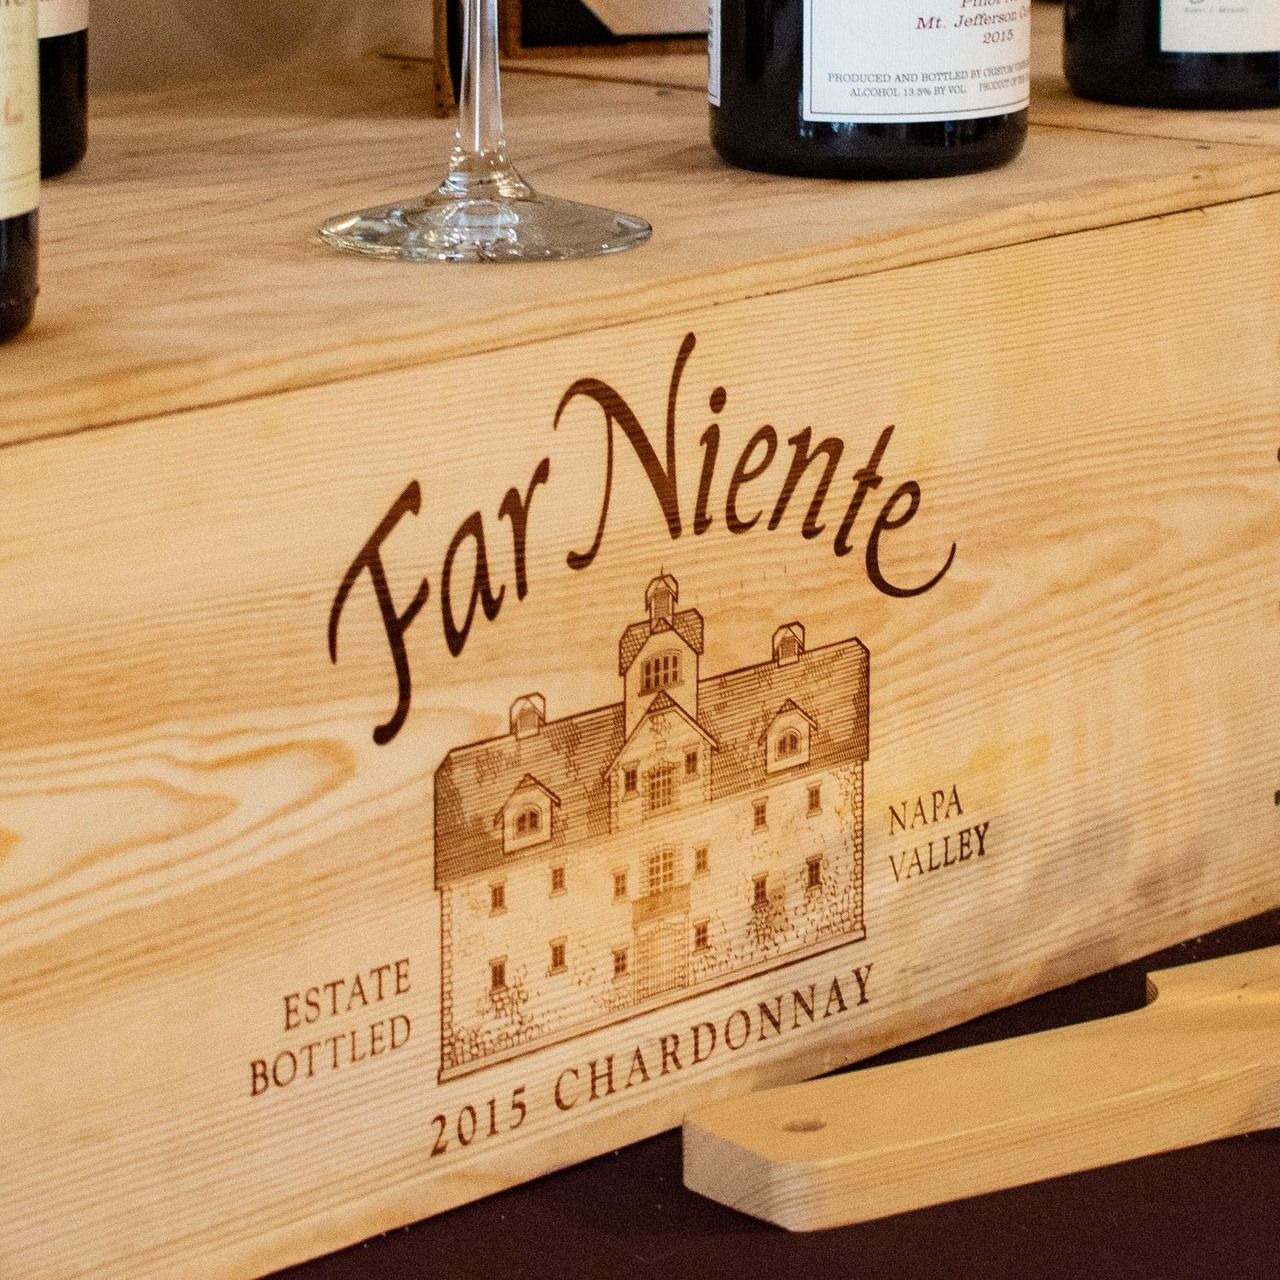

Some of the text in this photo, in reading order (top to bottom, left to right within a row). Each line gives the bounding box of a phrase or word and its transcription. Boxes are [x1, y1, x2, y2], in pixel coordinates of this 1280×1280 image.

[915, 10, 1018, 31] Mt. Jefferson
[982, 29, 1014, 45] 2015
[828, 72, 891, 83] PRODUCED
[894, 72, 919, 83] AND
[921, 70, 969, 82] BOTTLED
[850, 87, 900, 98] ALCOHOL
[327, 331, 957, 746] Far Niente
[887, 783, 965, 836] NAPA
[888, 821, 991, 885] VALLEY
[282, 957, 412, 1033] ESTATE
[249, 1013, 413, 1097] BOTTLED
[430, 963, 875, 1158] 2015 CHARDONNAY
